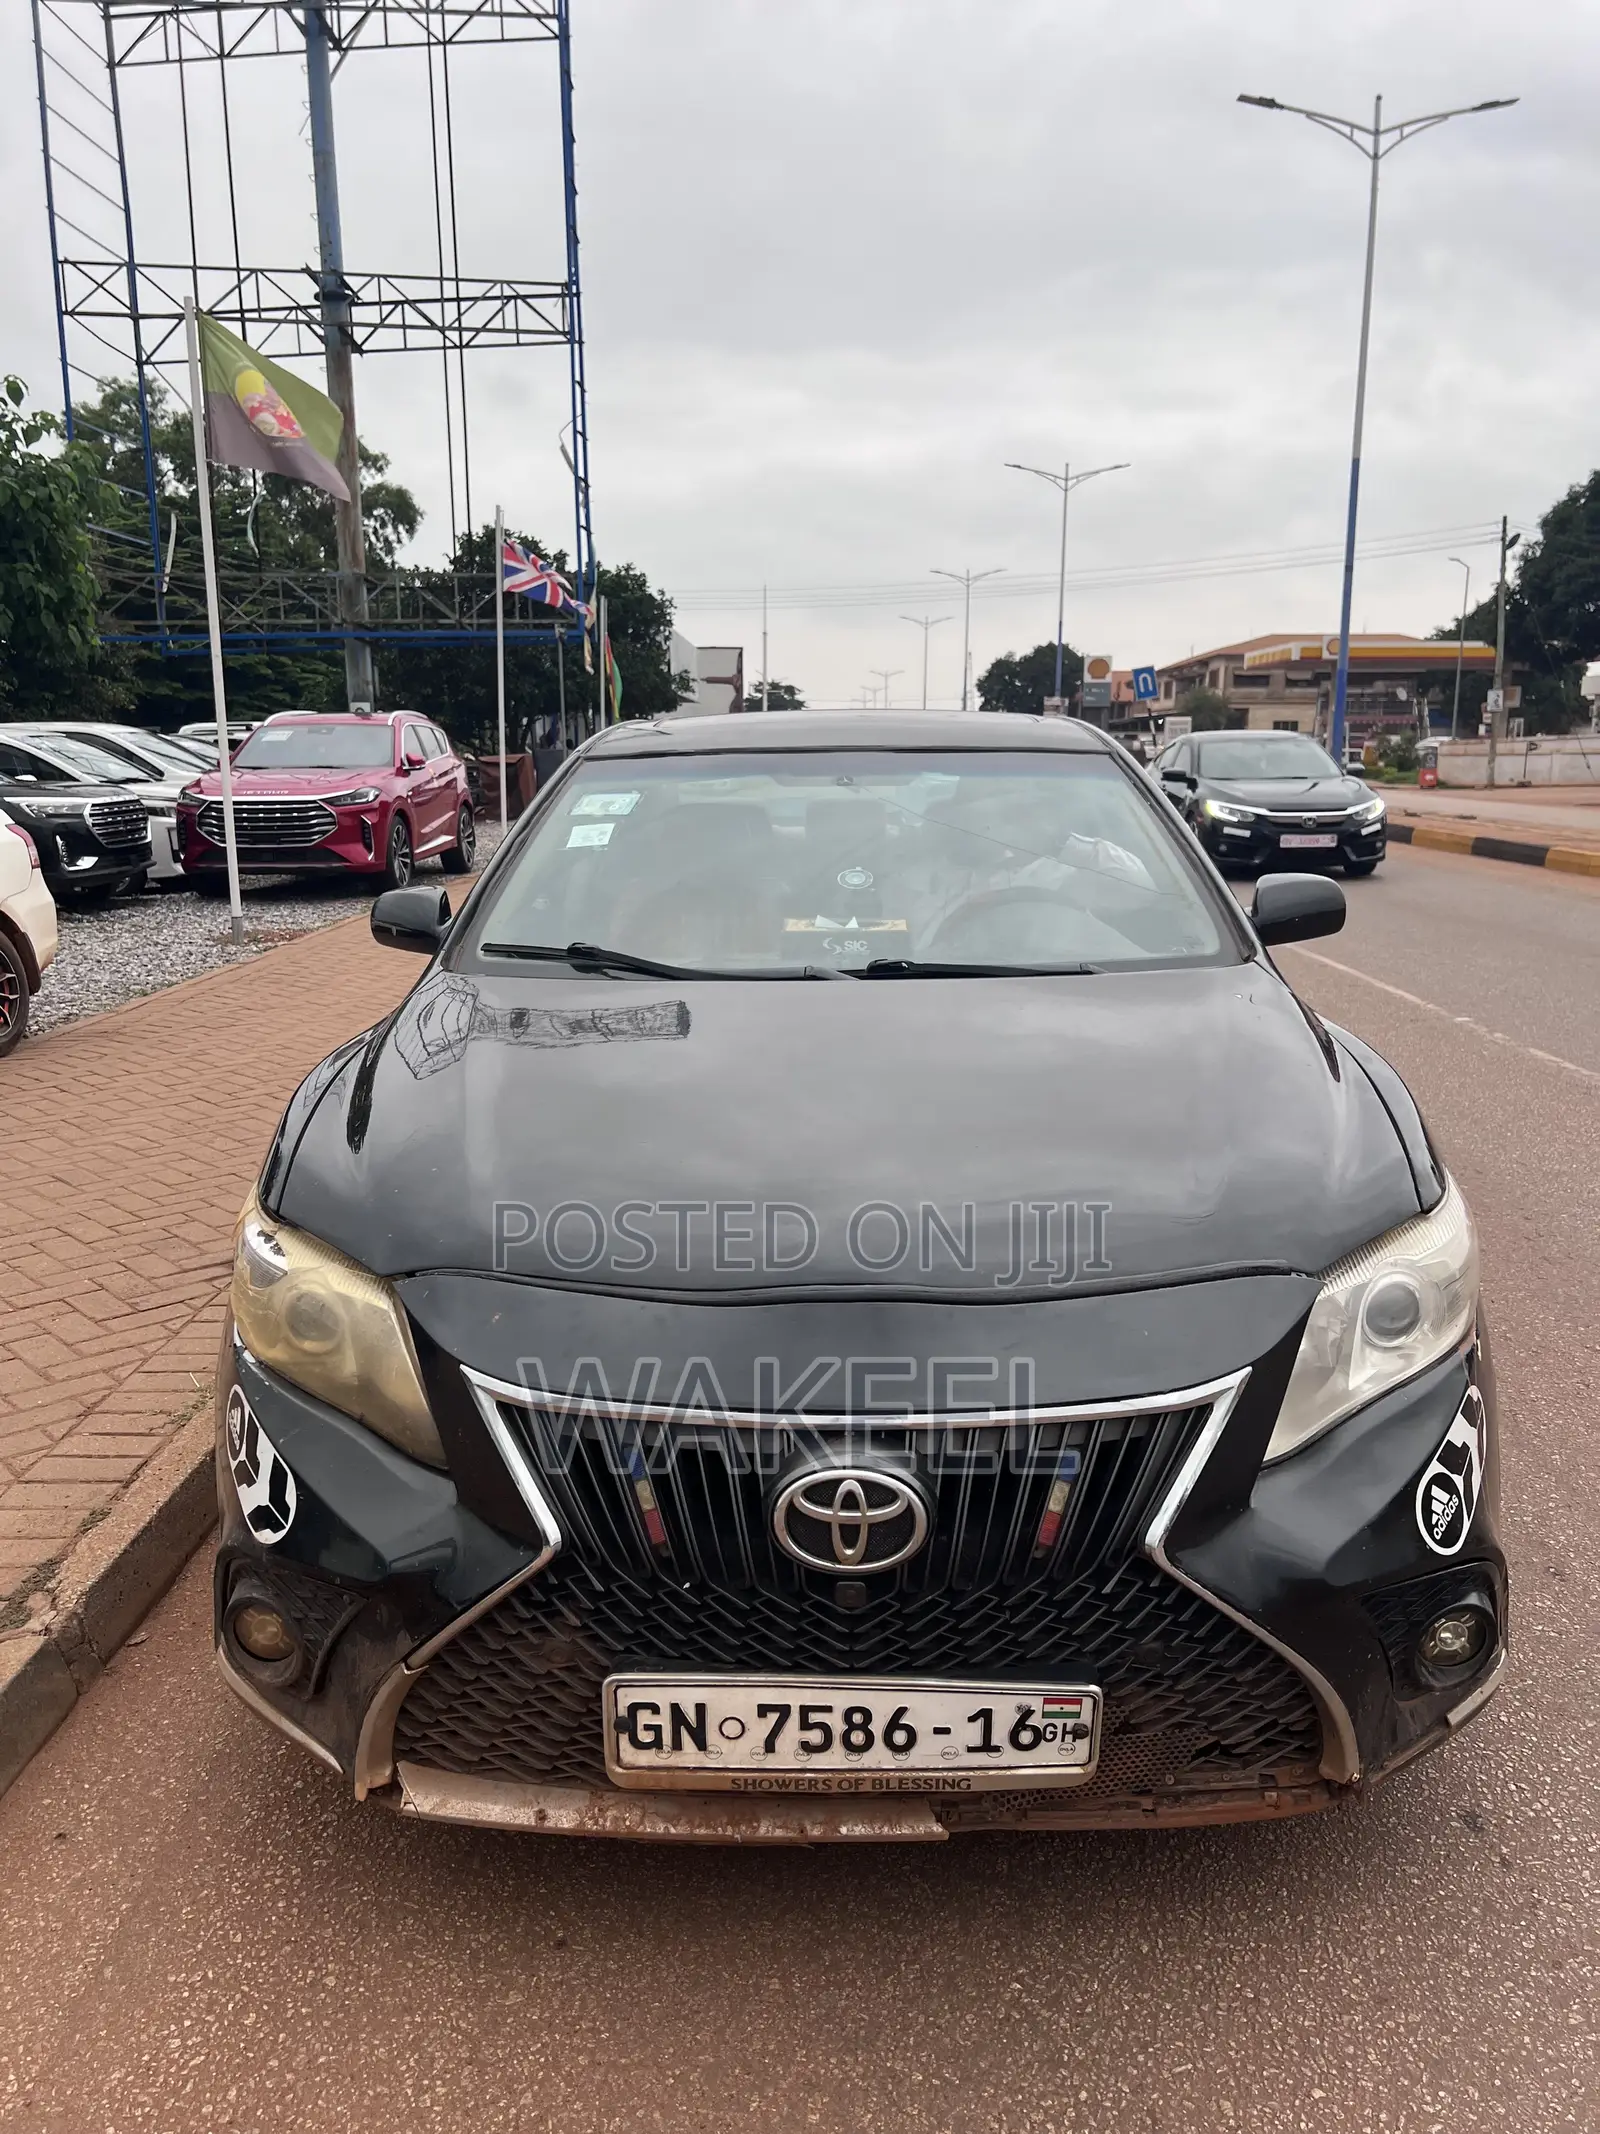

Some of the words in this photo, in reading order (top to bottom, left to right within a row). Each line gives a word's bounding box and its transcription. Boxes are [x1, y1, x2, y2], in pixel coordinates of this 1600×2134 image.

[844, 939, 868, 952] SIC
[1433, 1494, 1459, 1540] adidas
[626, 1702, 708, 1752] GN
[1042, 1722, 1077, 1743] GH
[730, 1778, 833, 1792] SHOWERS
[836, 1778, 867, 1791] OF
[871, 1777, 973, 1792] BLESSING
